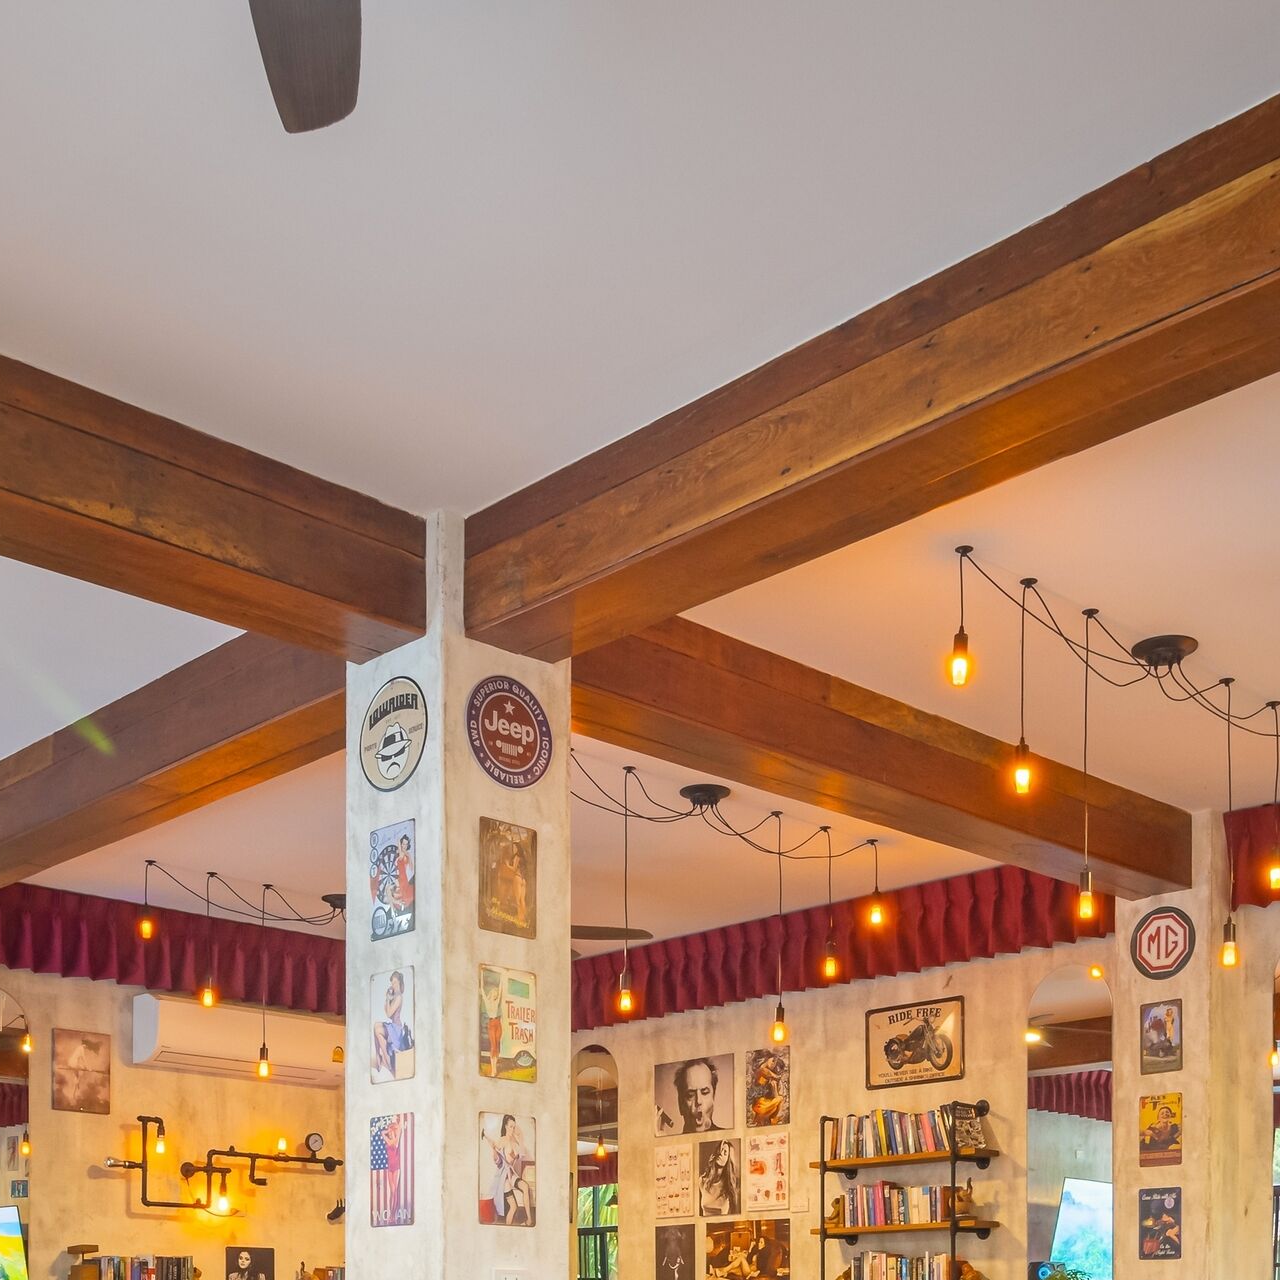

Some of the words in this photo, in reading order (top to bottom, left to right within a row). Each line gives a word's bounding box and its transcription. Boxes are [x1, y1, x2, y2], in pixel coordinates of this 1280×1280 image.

[369, 693, 418, 731] LOWRIDER
[473, 680, 510, 707] SUPERIOR
[512, 684, 544, 721] QUALITY
[484, 710, 535, 745] Jeep
[484, 759, 525, 784] RELIABLE
[533, 736, 550, 775] ICONIC
[1148, 924, 1178, 960] MG
[505, 1000, 536, 1023] TRAILER
[887, 1010, 913, 1025] RIDE
[916, 1007, 942, 1018] FREE
[508, 1022, 534, 1044] TRASH
